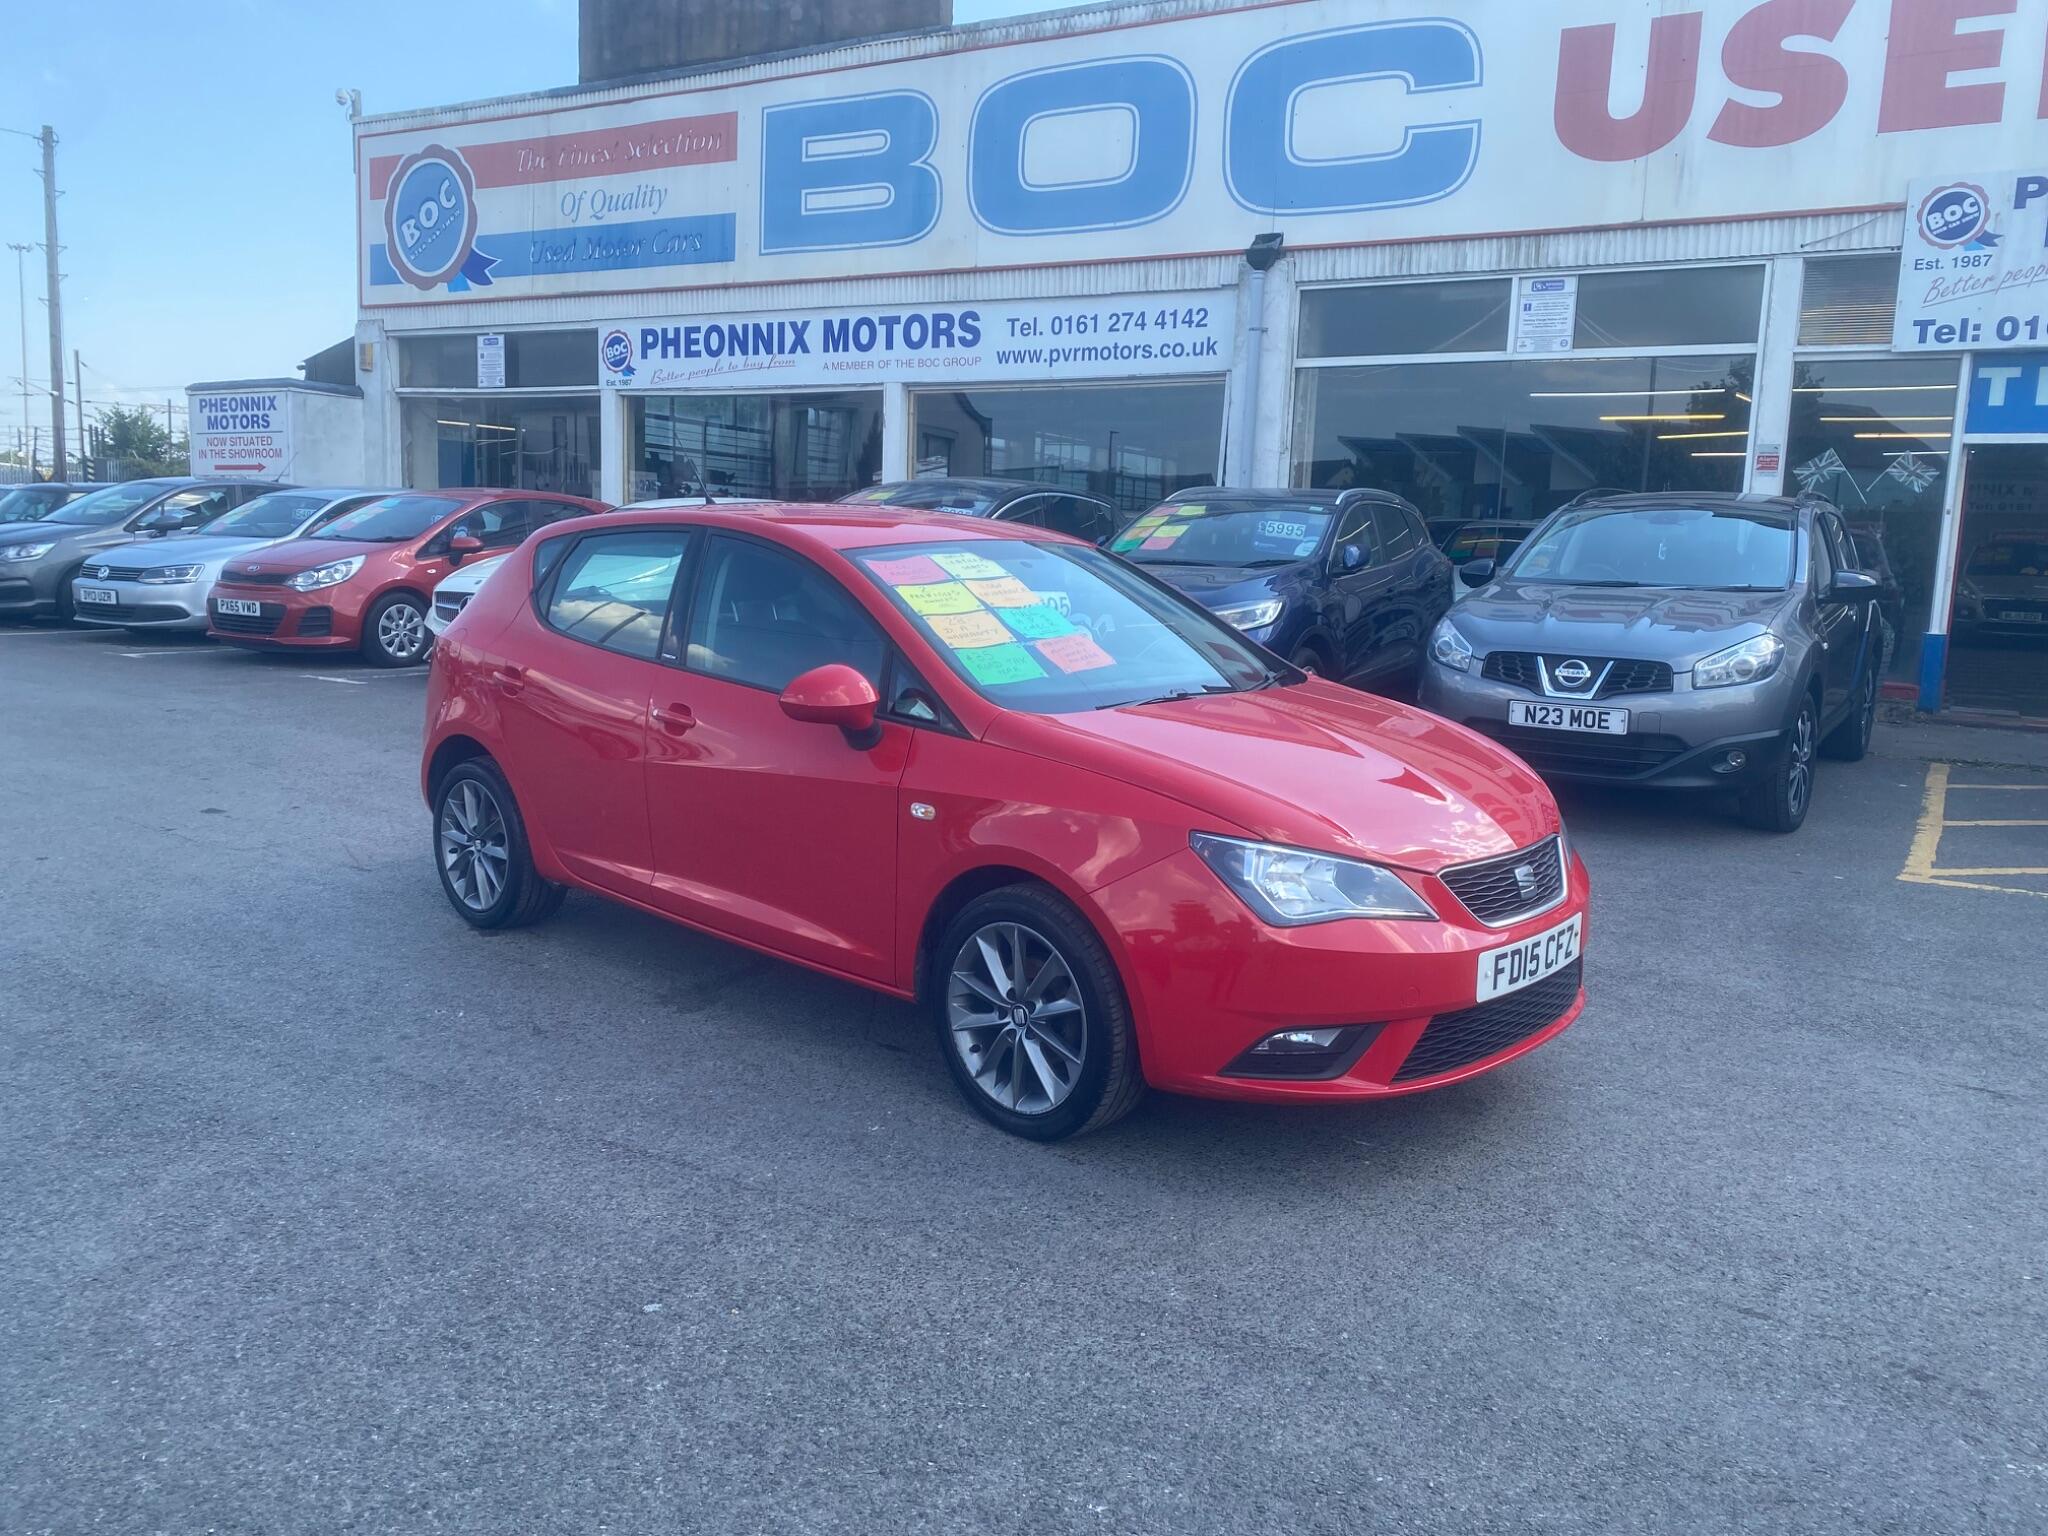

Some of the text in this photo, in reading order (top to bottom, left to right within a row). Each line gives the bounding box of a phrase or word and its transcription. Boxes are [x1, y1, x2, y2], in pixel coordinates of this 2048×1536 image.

[759, 0, 2048, 257] BOC USE
[401, 178, 457, 249] BOC
[560, 184, 668, 223] Of Quality
[1927, 196, 1980, 231] BOC
[529, 228, 703, 264] Used Motor Cars
[1914, 254, 1993, 271] Est. 1987
[1922, 264, 2048, 305] Better peop
[640, 310, 982, 360] PHEONNIX MOTORS
[1006, 307, 1209, 337] Tel. 0161 274 4142
[1912, 314, 2048, 344] Tel: 01
[606, 341, 628, 359] BOC
[823, 356, 982, 371] A MEMBER OF THE BOC GROUP
[996, 336, 1218, 367] www.pvrmotors.co.uk
[650, 352, 796, 385] Better people to buy from
[199, 395, 278, 413] PHEONNIX
[207, 413, 271, 430] MOTORS
[198, 448, 283, 459] IN THE SHOWROOM
[206, 436, 273, 447] NOW SITUATED
[220, 600, 240, 612] PX65
[1557, 669, 1588, 677] NISSAN
[1524, 705, 1611, 730] N23 MOE
[1492, 923, 1575, 991] FD15 CFZ
